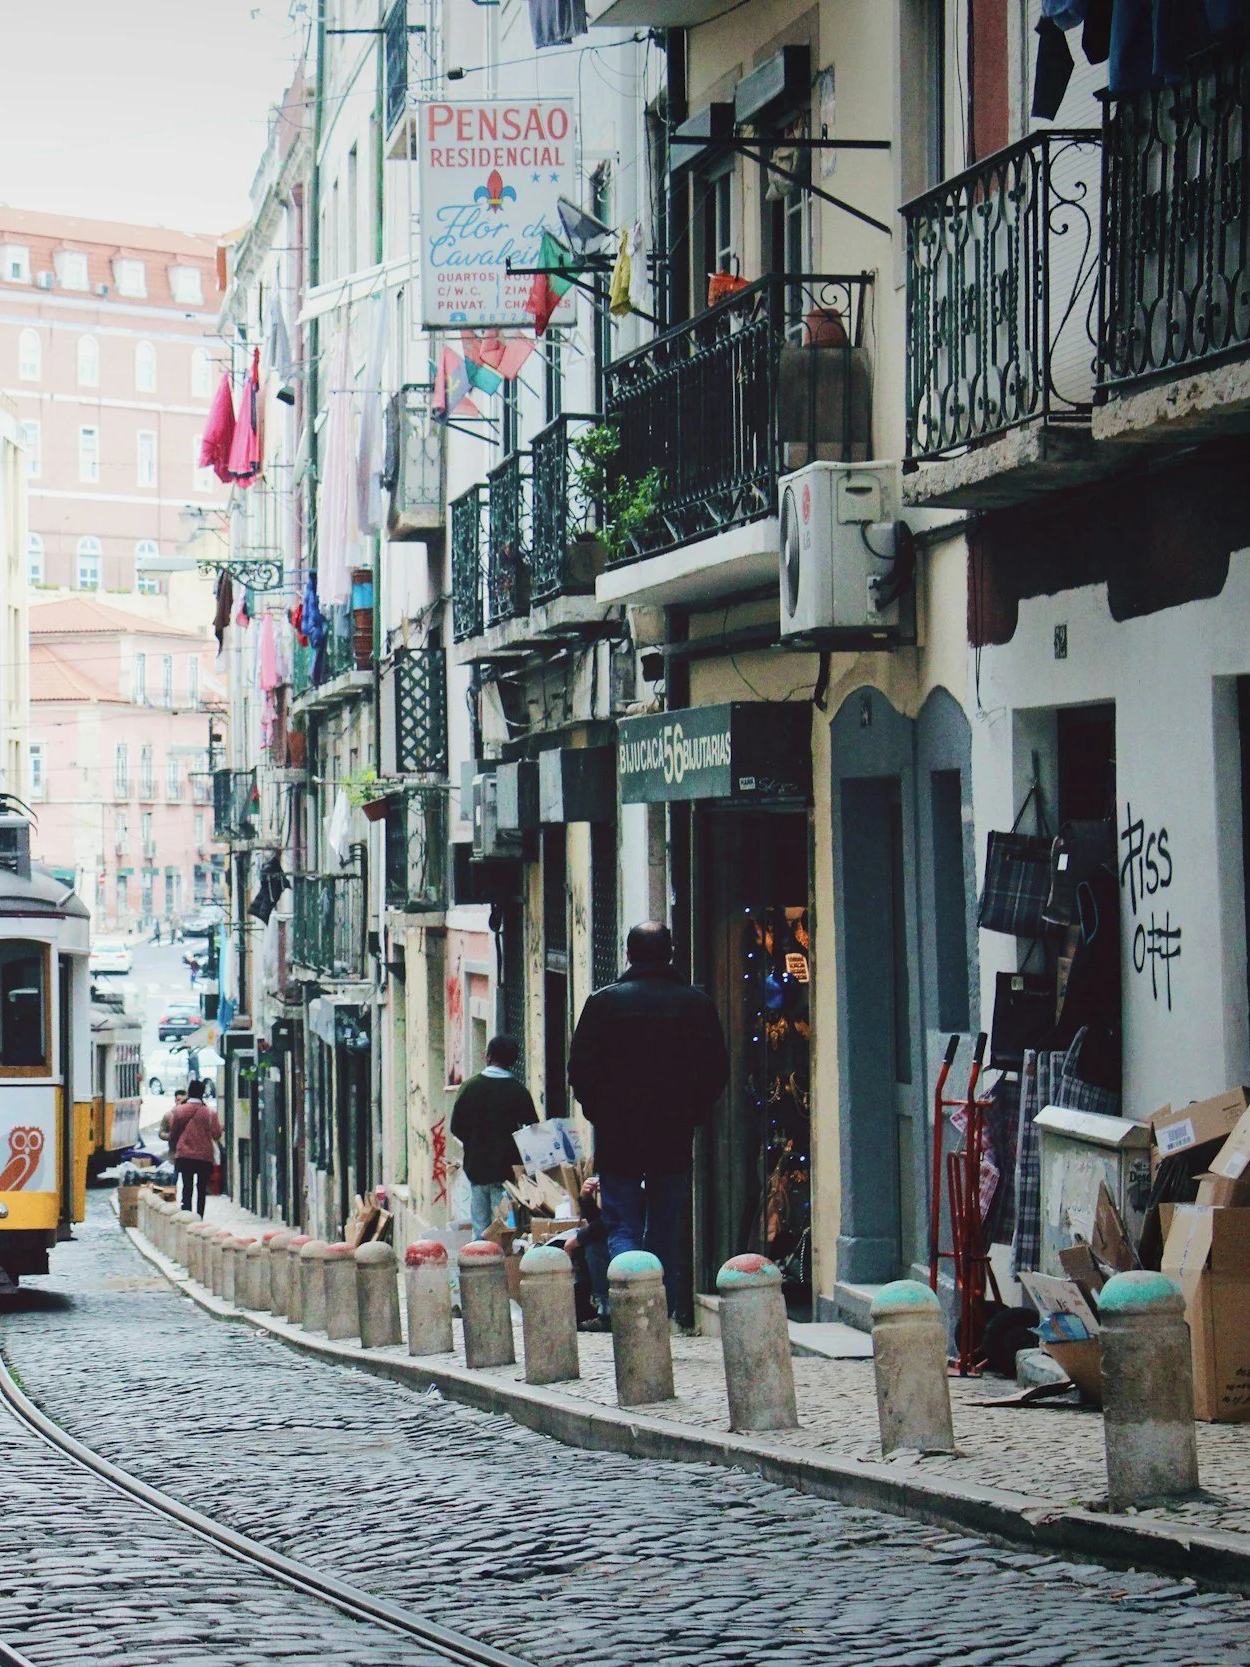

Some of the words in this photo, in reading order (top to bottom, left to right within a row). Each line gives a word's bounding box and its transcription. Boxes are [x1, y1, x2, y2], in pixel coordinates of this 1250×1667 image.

[430, 146, 565, 168] RESIDENCIAL
[437, 272, 495, 282] QUARTOS
[437, 301, 486, 310] PRIVAT.
[663, 722, 684, 785] 56
